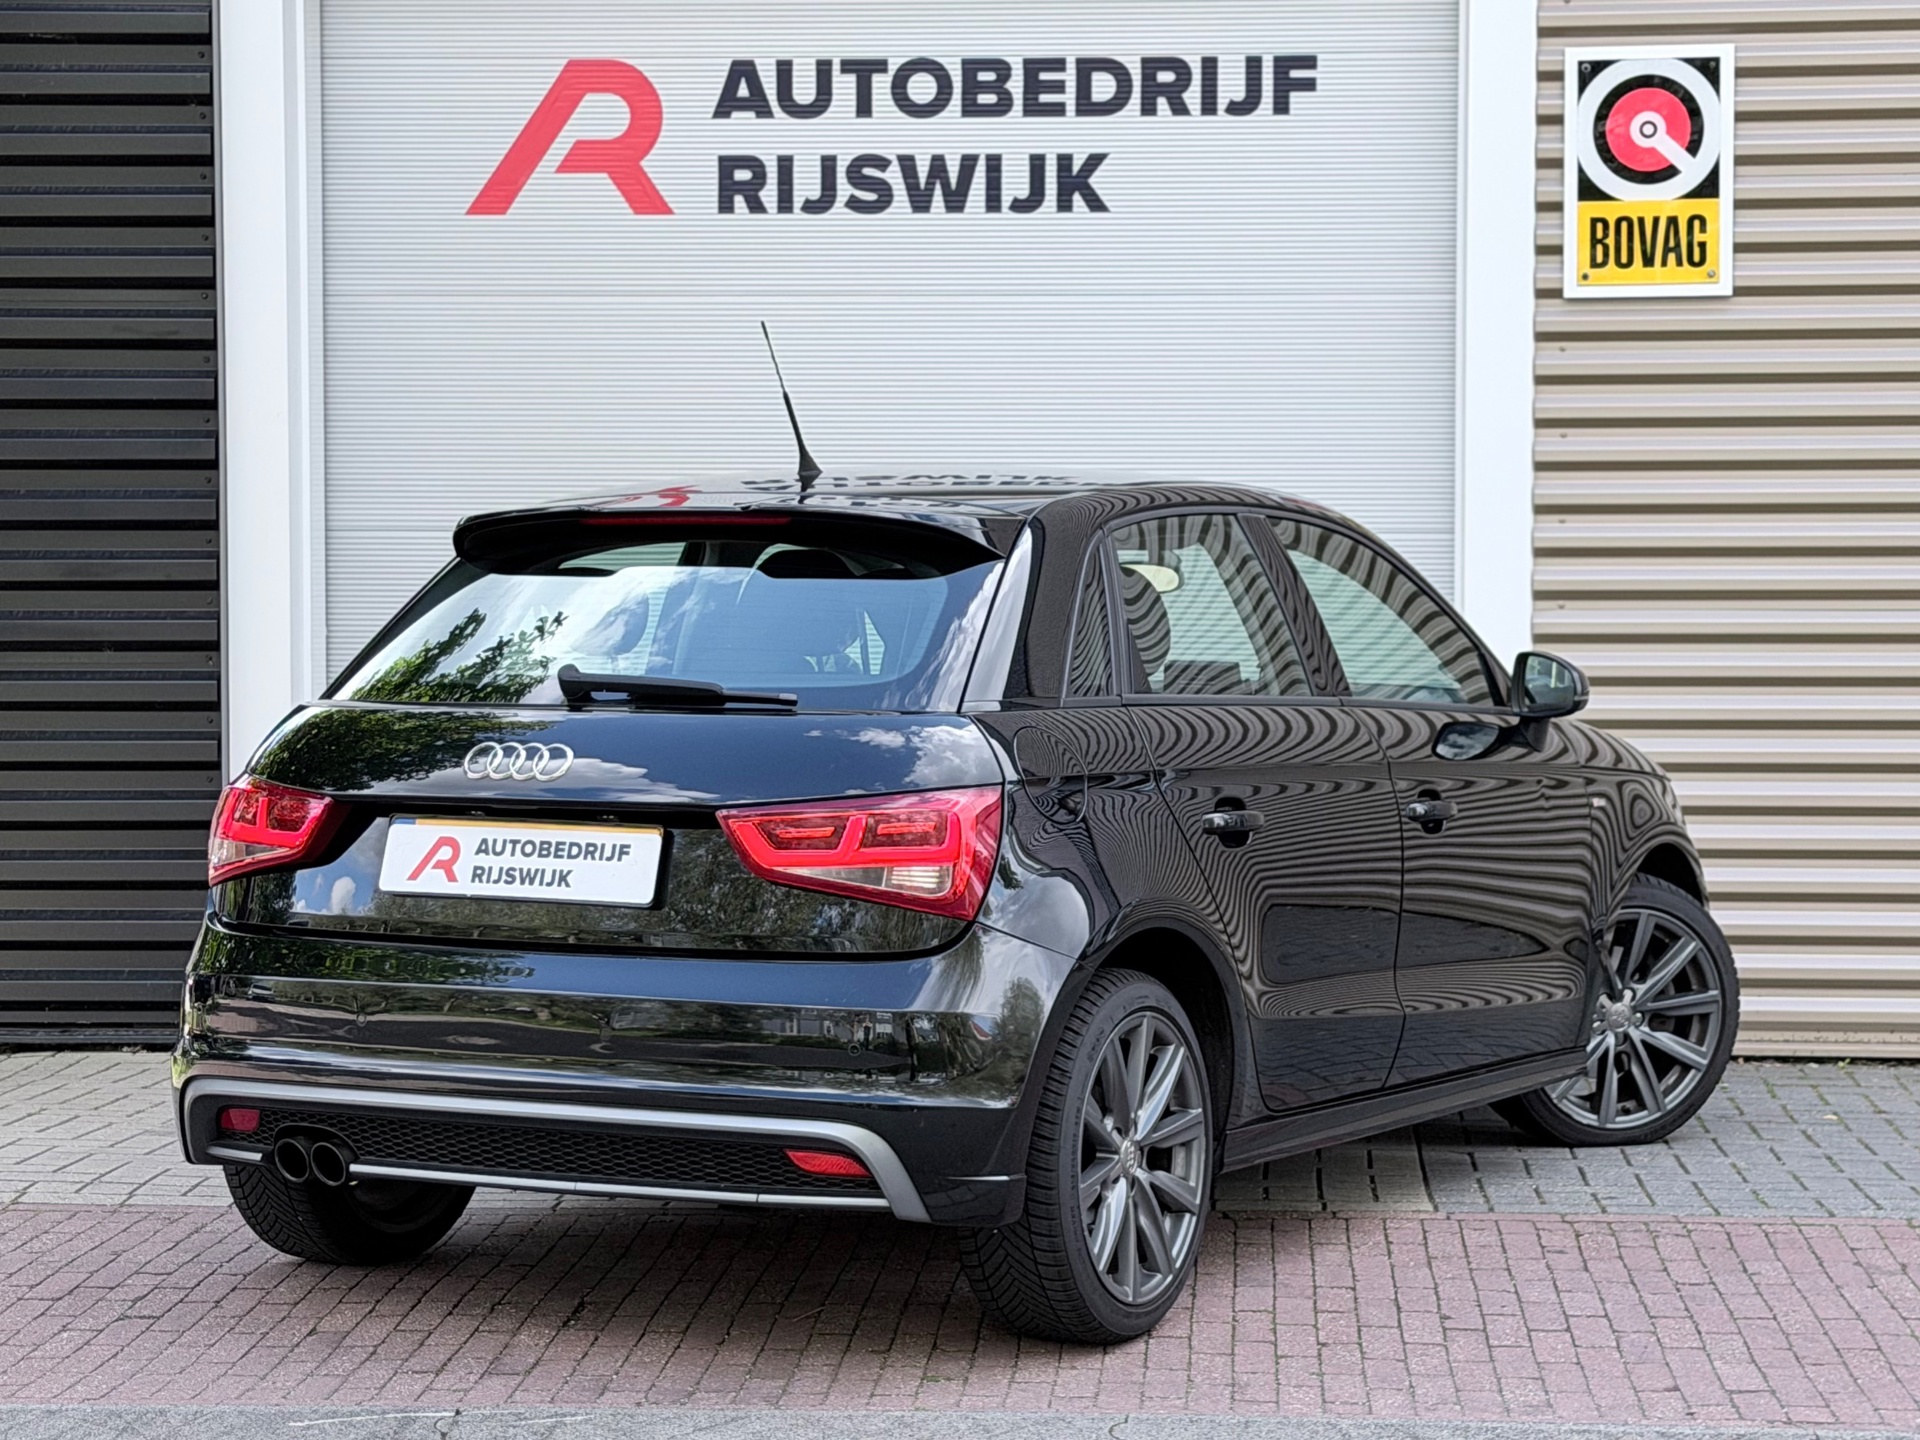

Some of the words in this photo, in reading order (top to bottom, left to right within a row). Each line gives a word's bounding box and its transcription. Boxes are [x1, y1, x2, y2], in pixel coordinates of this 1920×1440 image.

[712, 55, 1318, 119] AUTOBEDRIJF
[717, 152, 1111, 214] RIJSWIJK
[1589, 214, 1708, 269] BOVAG
[470, 866, 573, 888] RIJSWIJK
[474, 838, 632, 862] AUTOBEDRIJF
